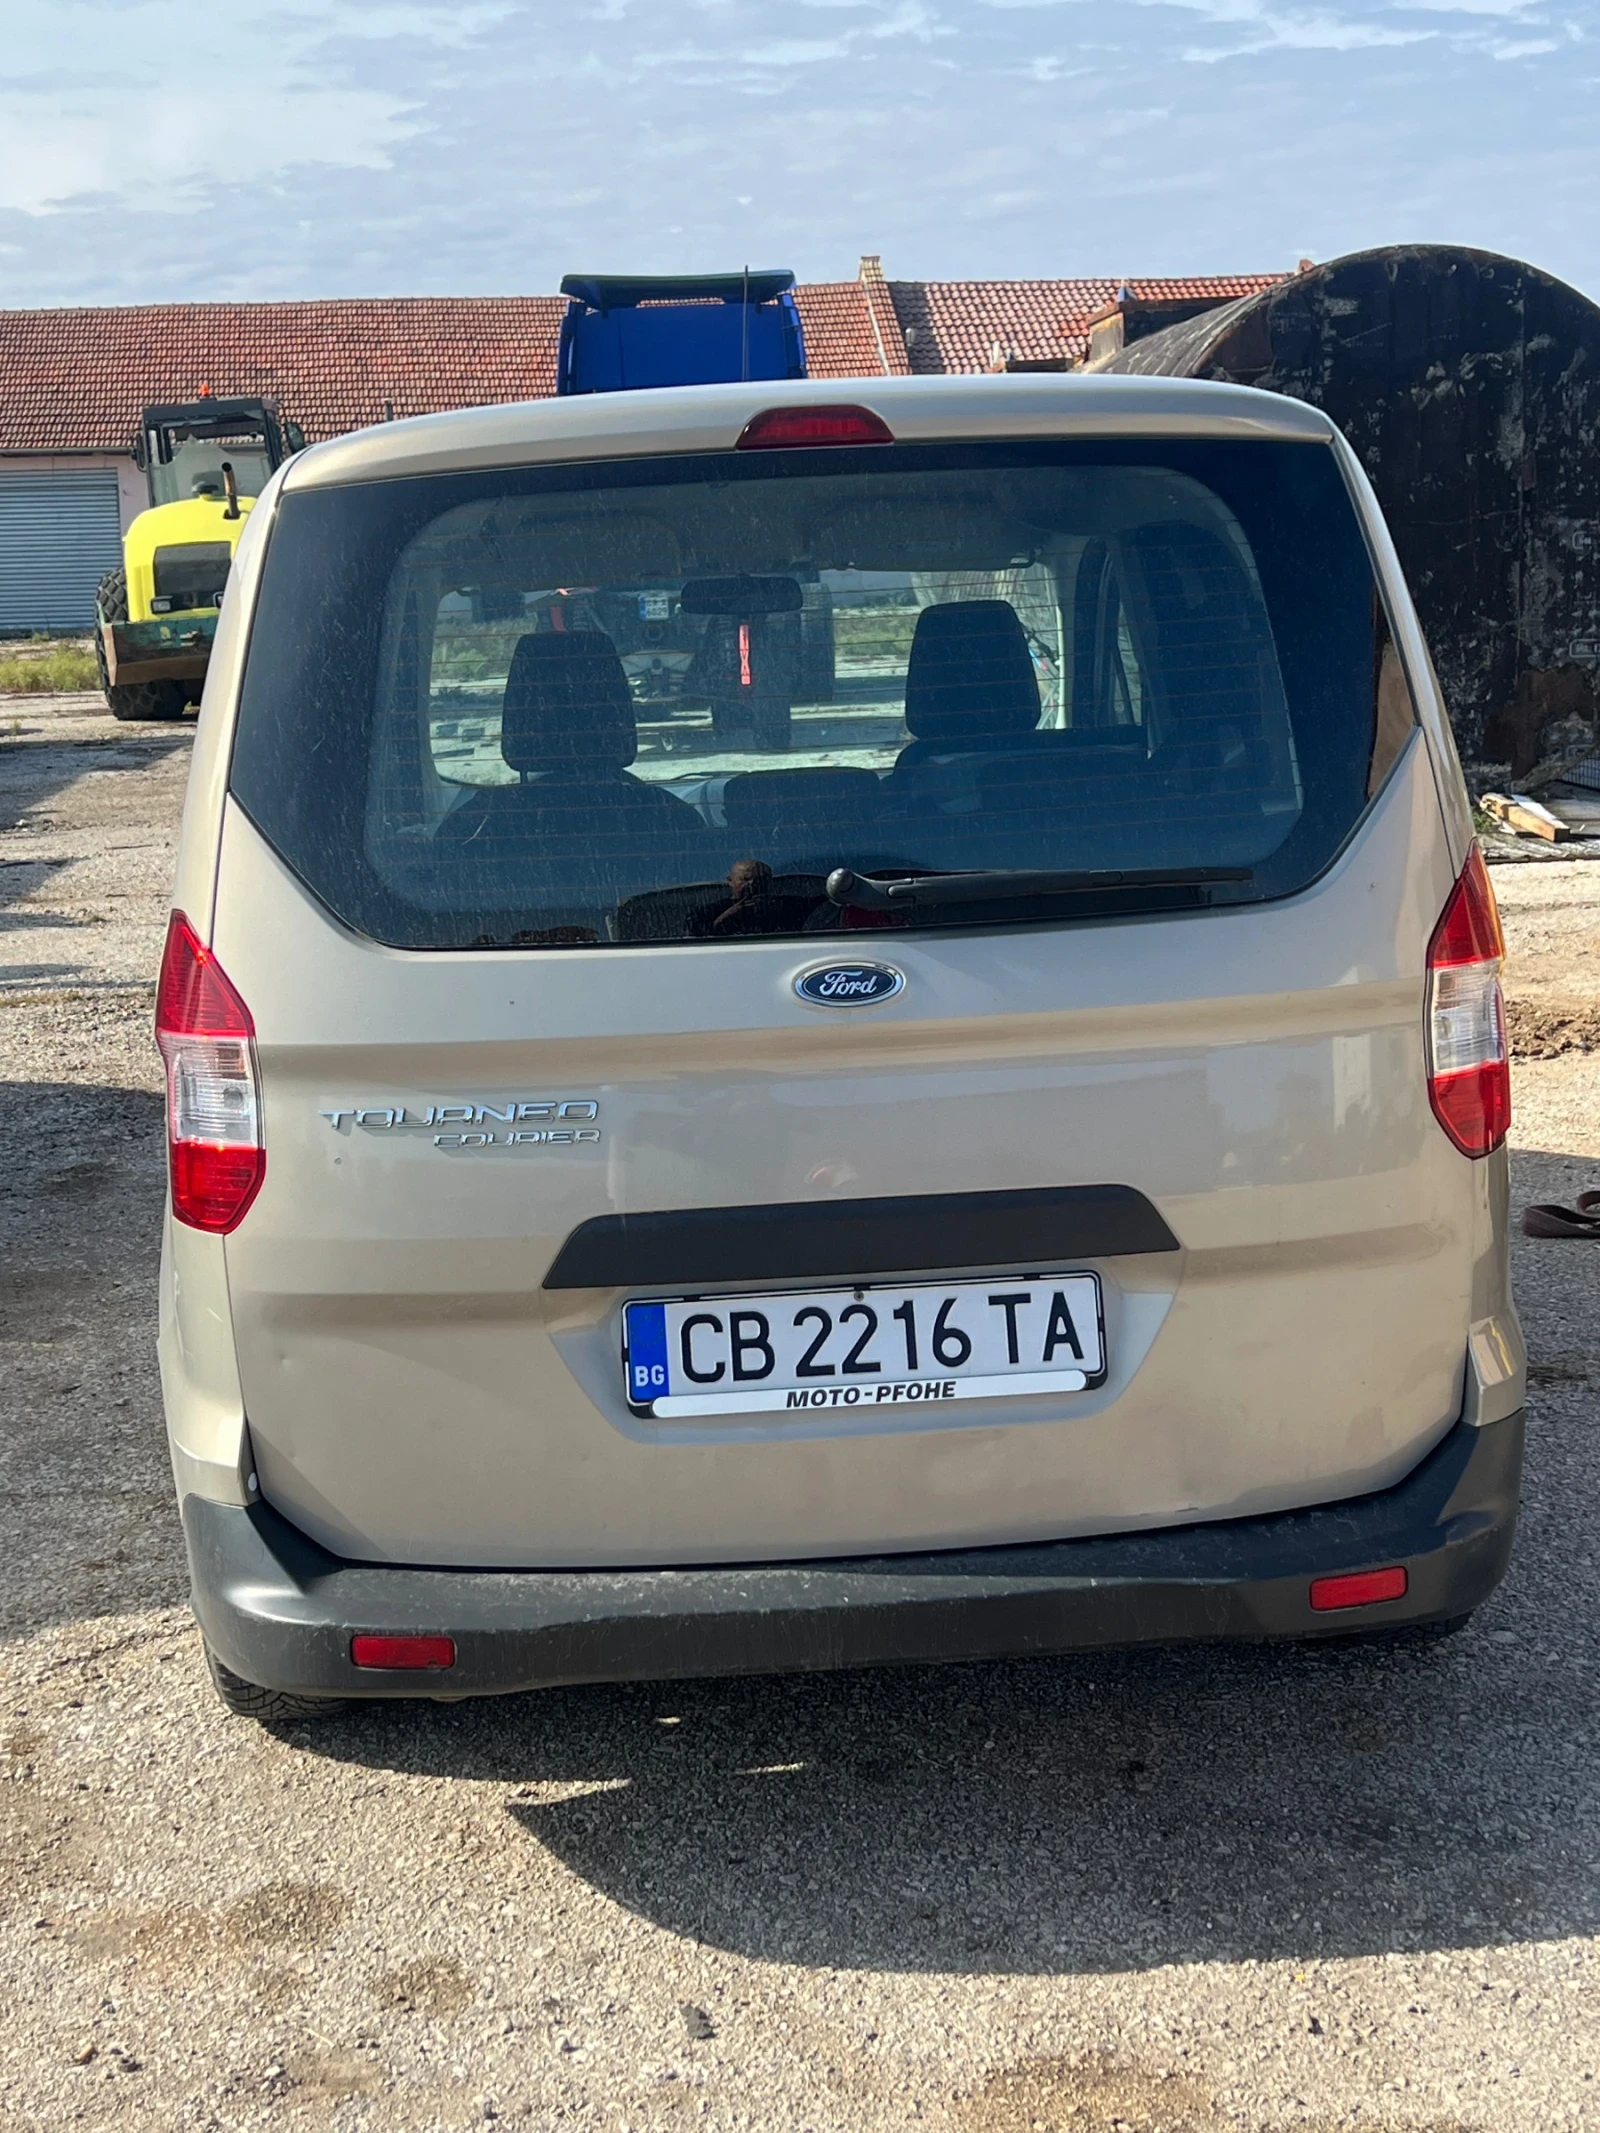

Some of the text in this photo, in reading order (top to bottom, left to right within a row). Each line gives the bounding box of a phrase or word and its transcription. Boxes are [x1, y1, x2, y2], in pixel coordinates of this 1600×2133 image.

[819, 970, 878, 996] Ford
[318, 1100, 599, 1130] TOURNEO
[433, 1129, 600, 1148] COURIER
[680, 1292, 1084, 1384] CB 2216 TA
[634, 1364, 666, 1388] BG
[785, 1380, 957, 1409] MOTO-PFOHE
